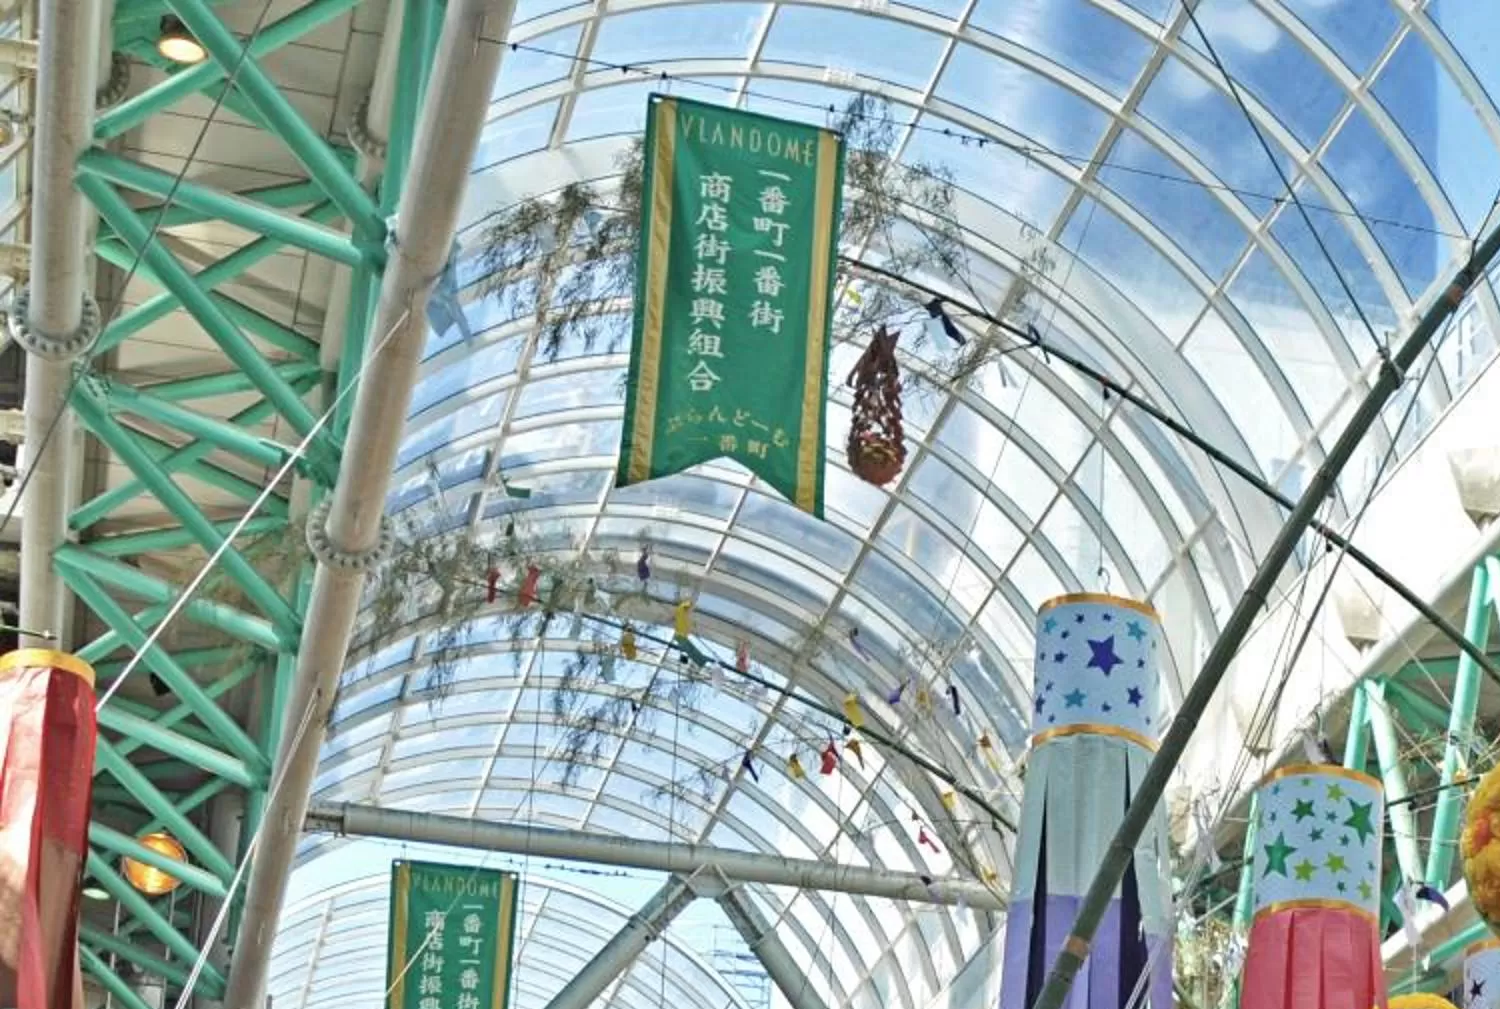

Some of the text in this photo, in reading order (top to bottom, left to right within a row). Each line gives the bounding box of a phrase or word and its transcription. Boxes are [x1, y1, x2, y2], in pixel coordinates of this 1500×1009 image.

[686, 172, 733, 392] 商店街振興組合
[747, 168, 791, 335] 一番町一番街
